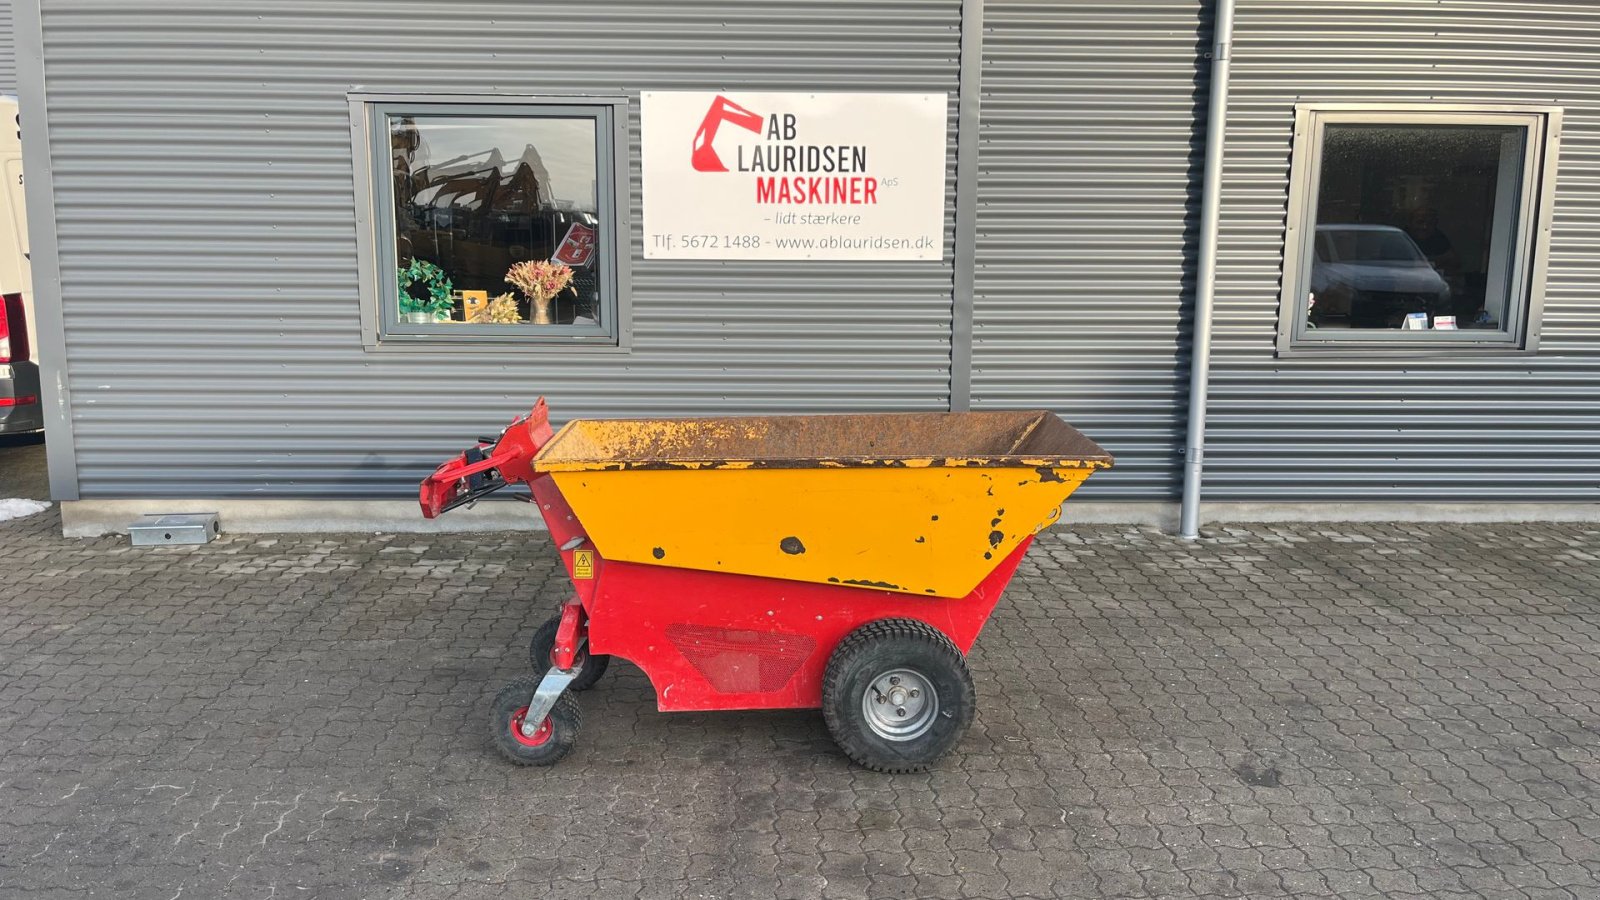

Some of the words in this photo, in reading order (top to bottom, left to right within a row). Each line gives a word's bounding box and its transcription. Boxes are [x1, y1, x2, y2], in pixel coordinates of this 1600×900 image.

[766, 113, 797, 141] AB
[738, 145, 867, 173] LAURIDSEN
[756, 176, 878, 205] MASKINER
[881, 177, 899, 187] ApS
[775, 211, 797, 225] lidt
[800, 212, 861, 225] stærkere
[652, 234, 676, 251] Tlf.
[681, 234, 719, 249] 5672
[723, 234, 761, 249] 1488
[775, 234, 934, 250] www.ablauridsen.dk
